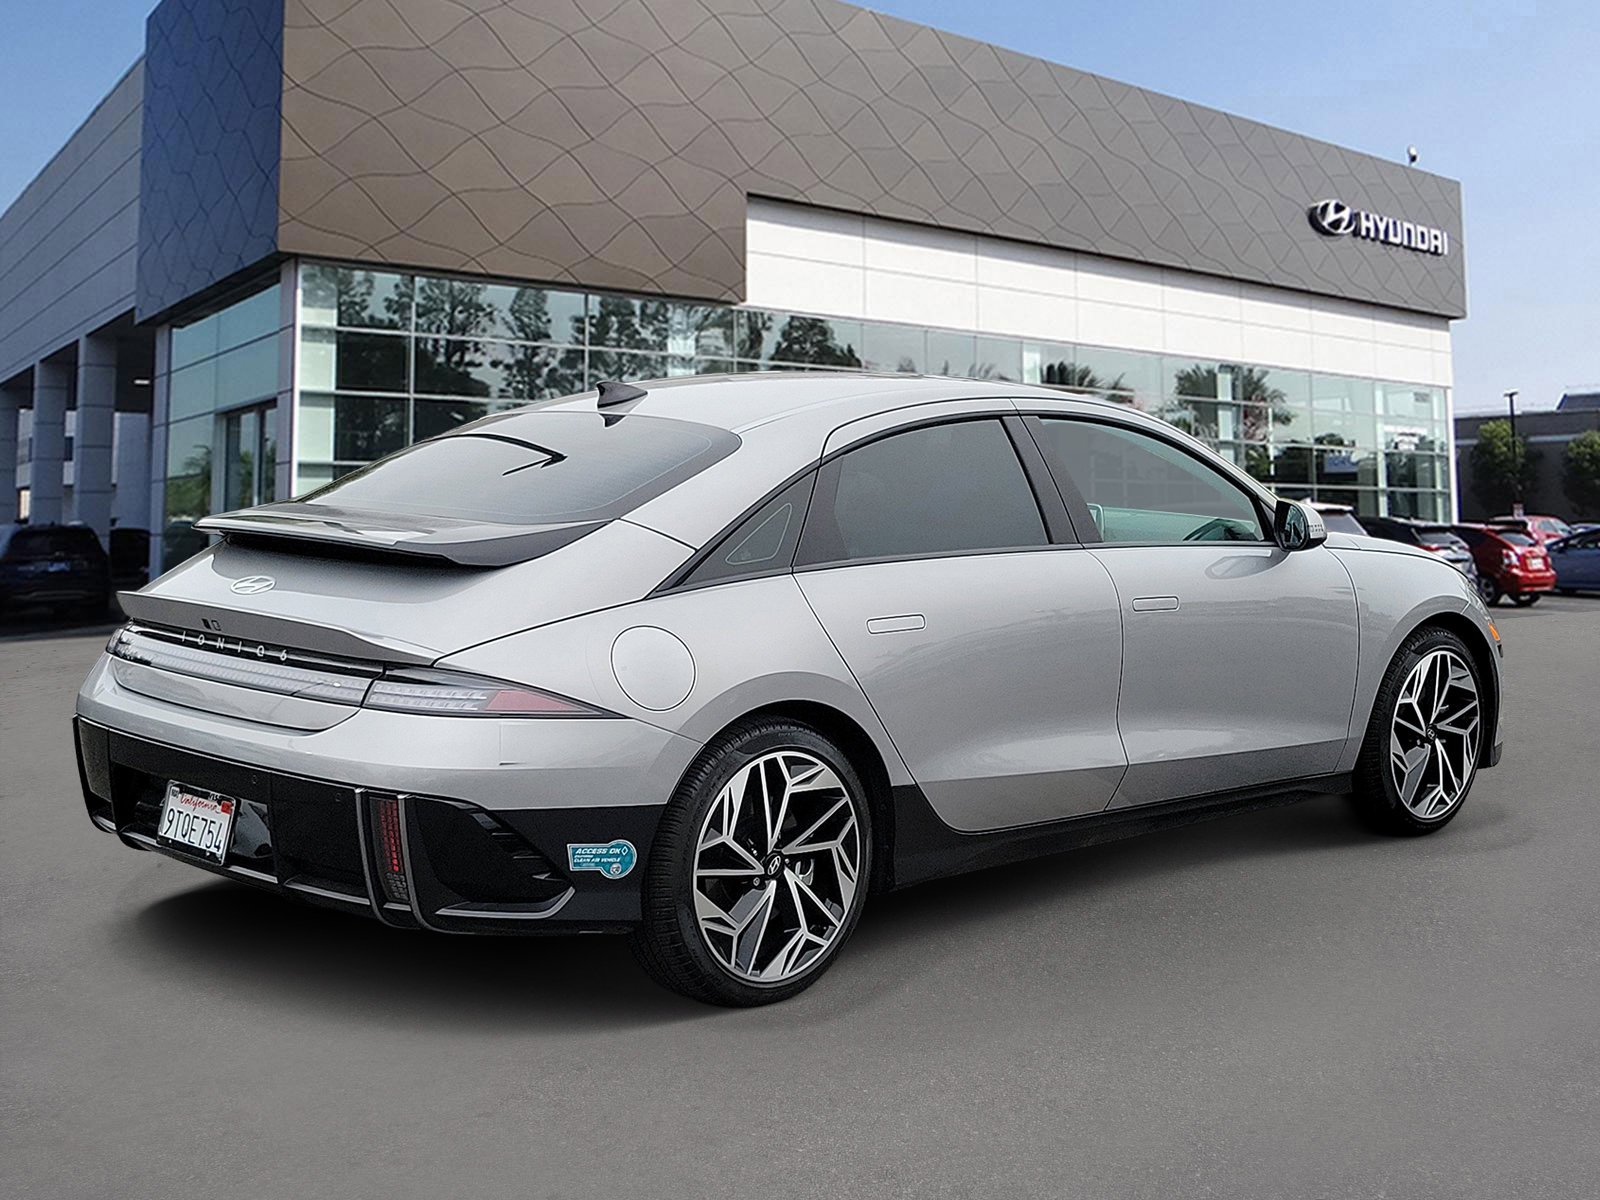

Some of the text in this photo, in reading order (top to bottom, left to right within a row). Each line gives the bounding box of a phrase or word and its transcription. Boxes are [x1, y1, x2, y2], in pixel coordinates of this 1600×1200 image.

[1360, 211, 1449, 256] HYUNDAI
[182, 630, 287, 661] IONIQ 6
